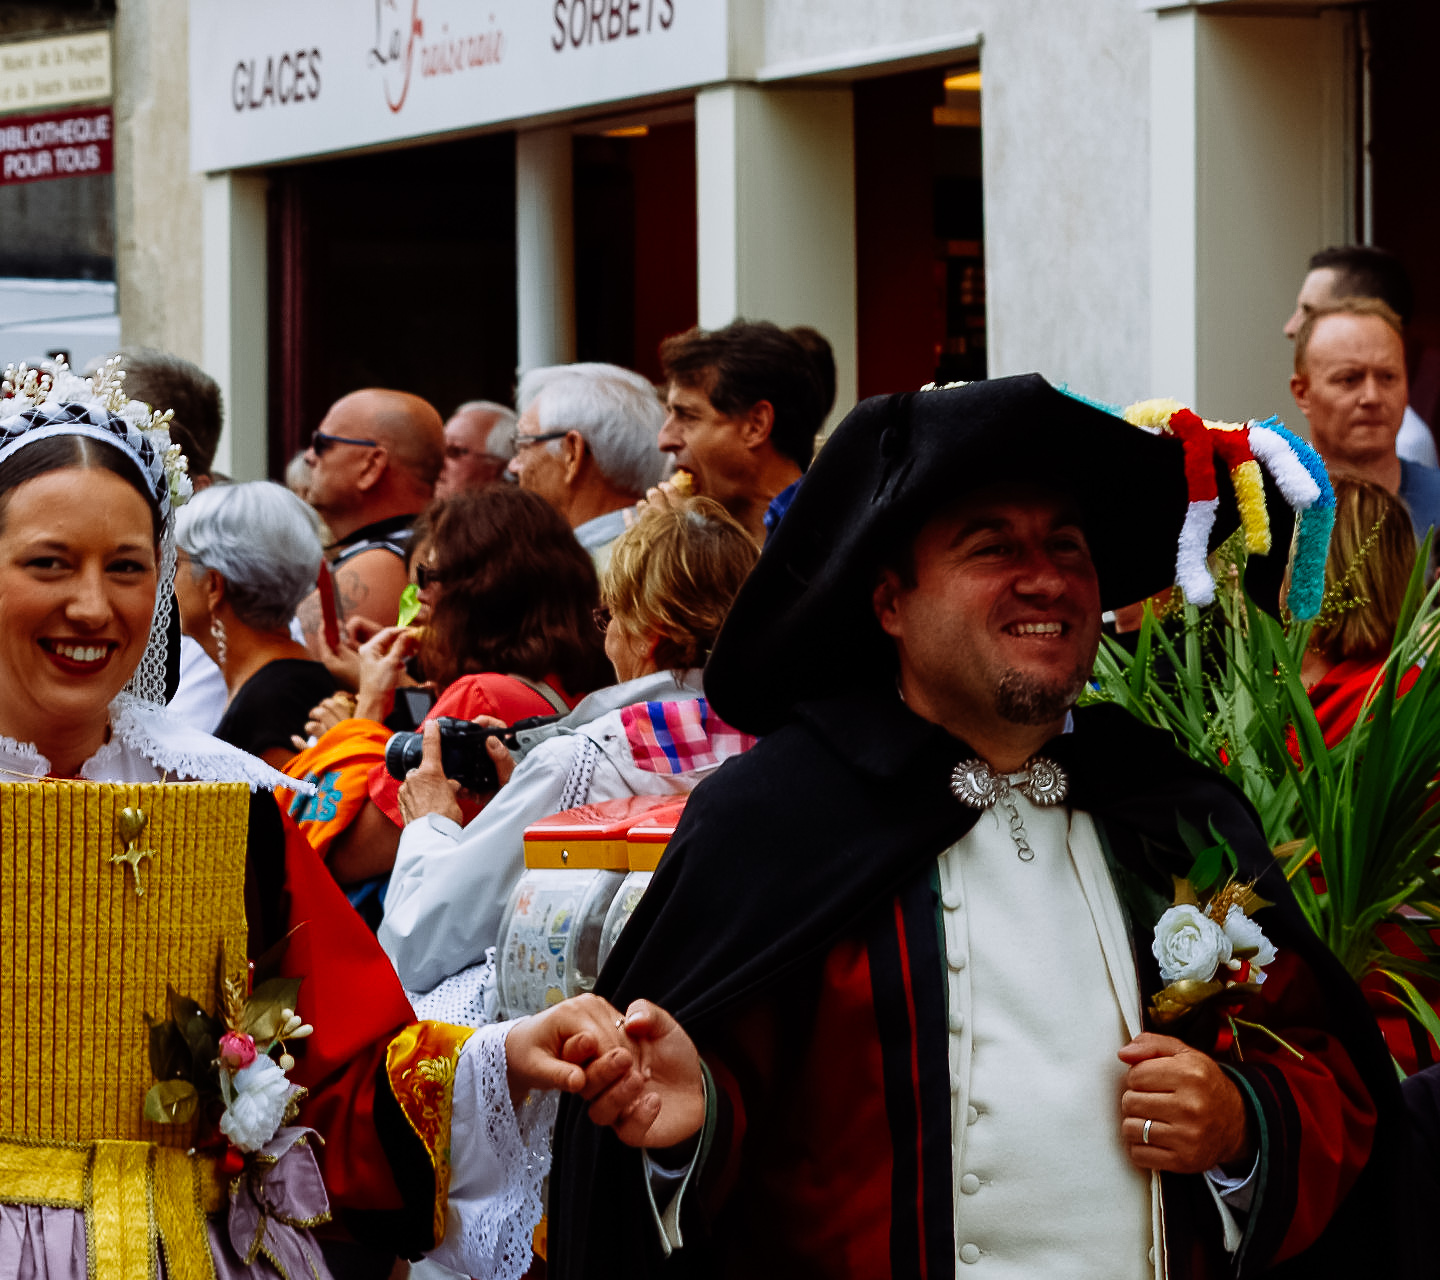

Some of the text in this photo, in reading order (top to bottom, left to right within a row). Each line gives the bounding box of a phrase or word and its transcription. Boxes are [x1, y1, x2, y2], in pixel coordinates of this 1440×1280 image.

[233, 47, 322, 112] GLACES
[2, 143, 101, 180] POUR TOUS
